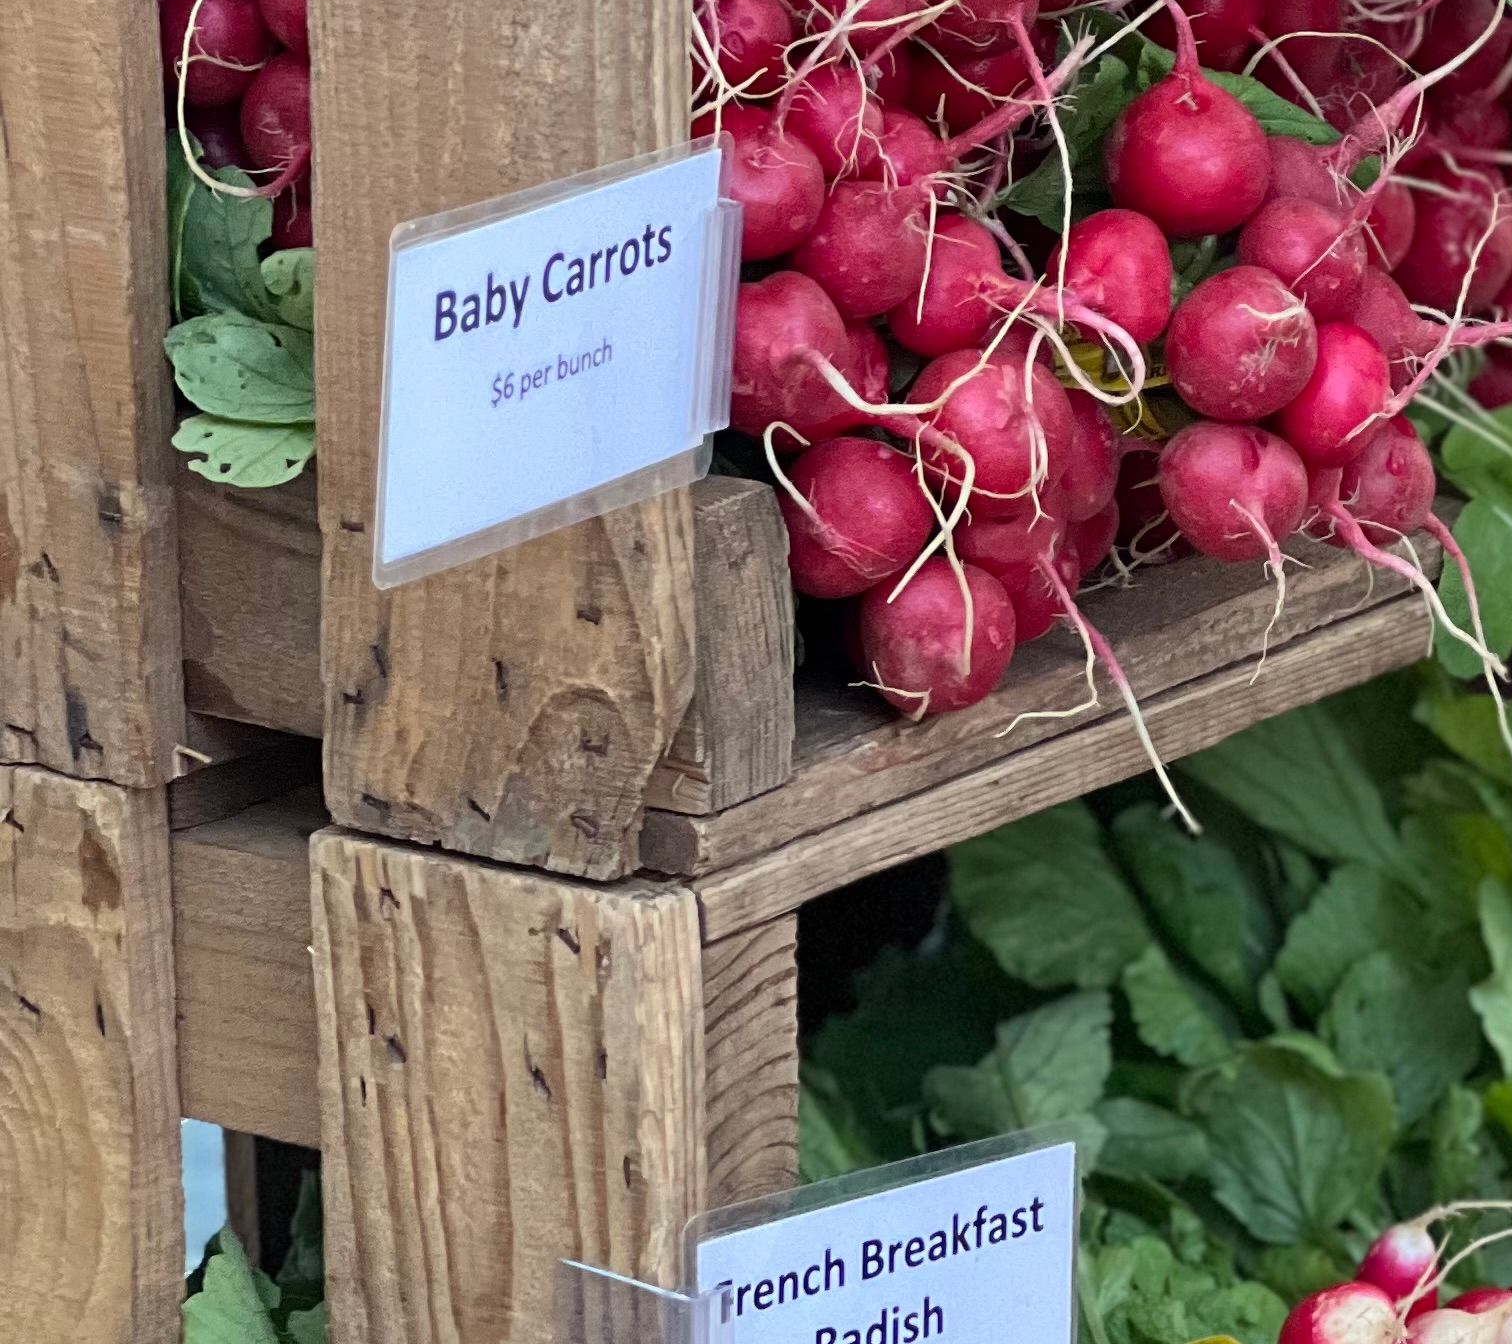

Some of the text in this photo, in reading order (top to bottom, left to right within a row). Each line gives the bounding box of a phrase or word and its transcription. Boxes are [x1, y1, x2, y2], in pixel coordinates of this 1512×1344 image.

[435, 223, 672, 341] Baby Carrots
[490, 337, 613, 409] $6 per bunch
[860, 1196, 1045, 1281] Breakfast
